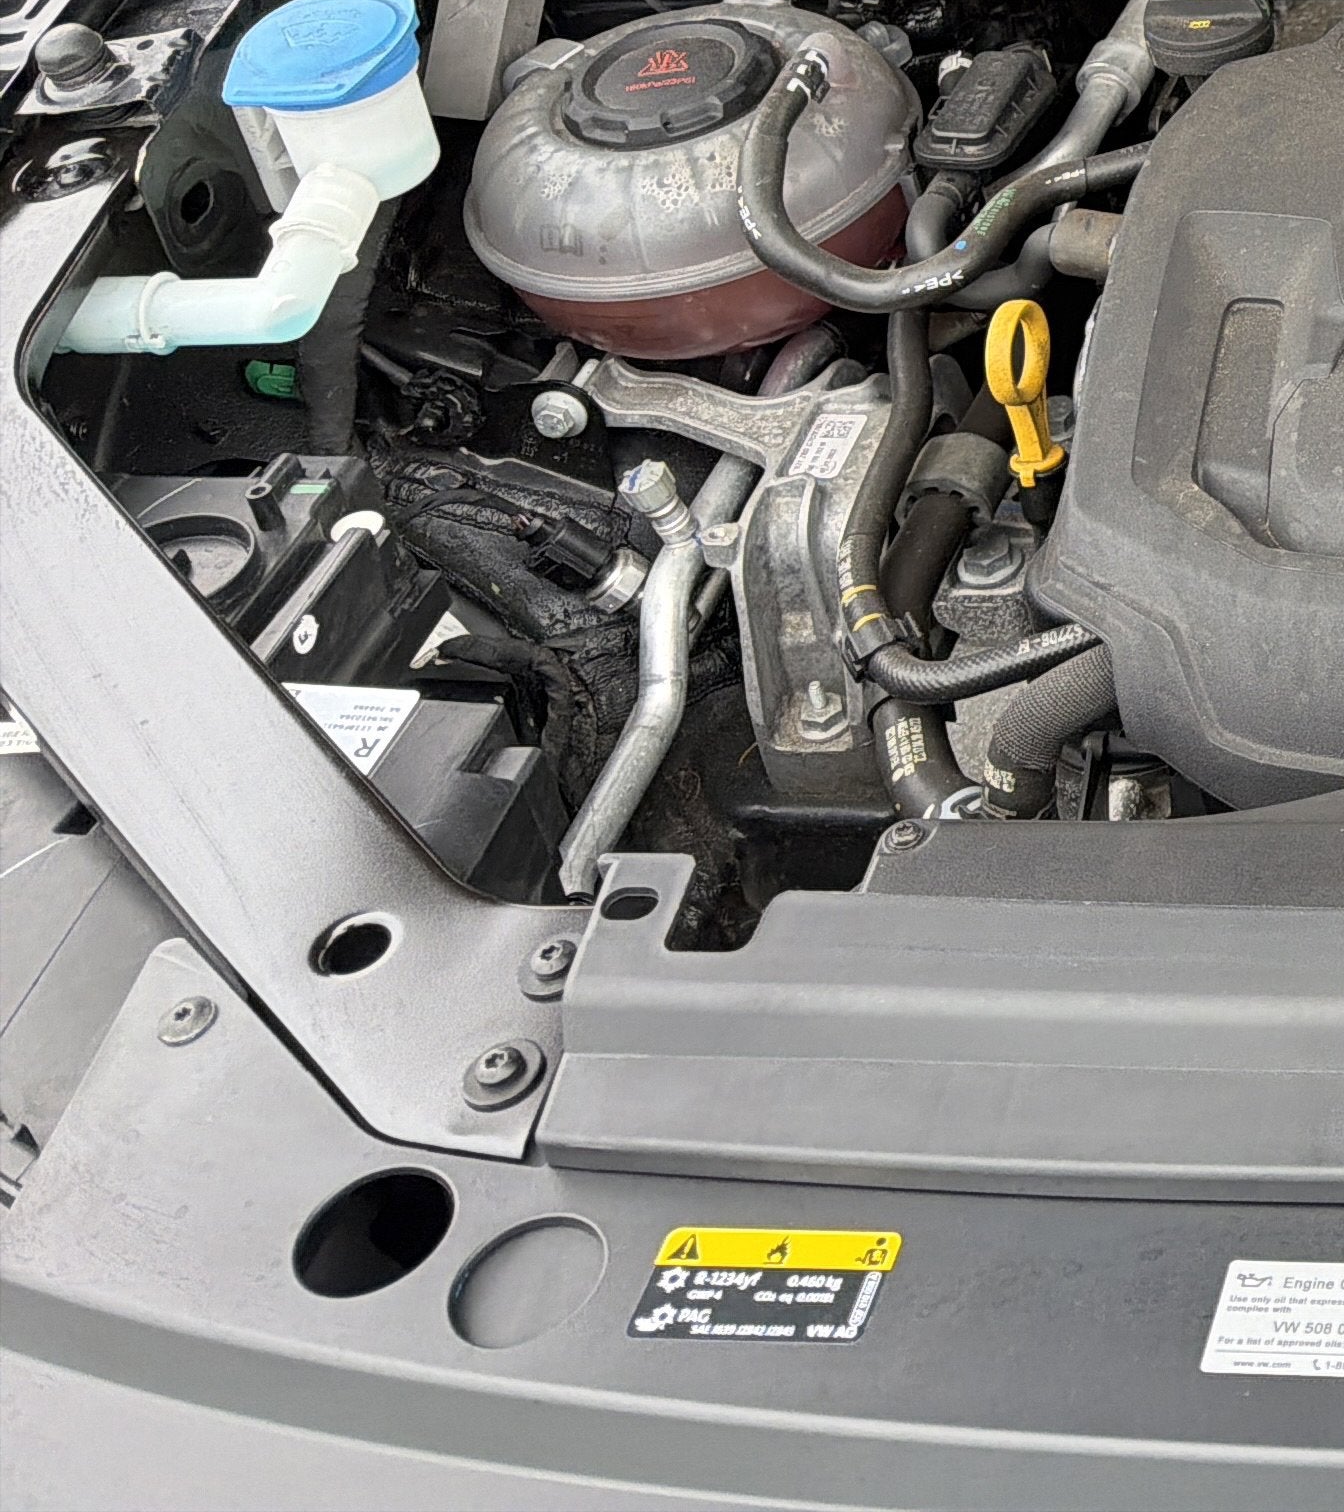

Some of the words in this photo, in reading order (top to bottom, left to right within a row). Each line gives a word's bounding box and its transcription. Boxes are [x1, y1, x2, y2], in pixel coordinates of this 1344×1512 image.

[353, 738, 381, 757] R
[1283, 1277, 1334, 1292] Engine
[1230, 1294, 1248, 1303] Use
[1251, 1295, 1271, 1305] only
[1274, 1296, 1286, 1304] oil
[1289, 1297, 1307, 1305] that
[677, 1308, 712, 1323] PAG
[1273, 1305, 1292, 1313] with
[806, 1325, 834, 1338] VW
[833, 1325, 858, 1339] AG
[1274, 1321, 1301, 1333] VW
[1304, 1322, 1333, 1334] 508
[1217, 1337, 1234, 1345] For
[1246, 1337, 1261, 1346] list
[1264, 1338, 1274, 1346] of
[1277, 1338, 1322, 1349] approved
